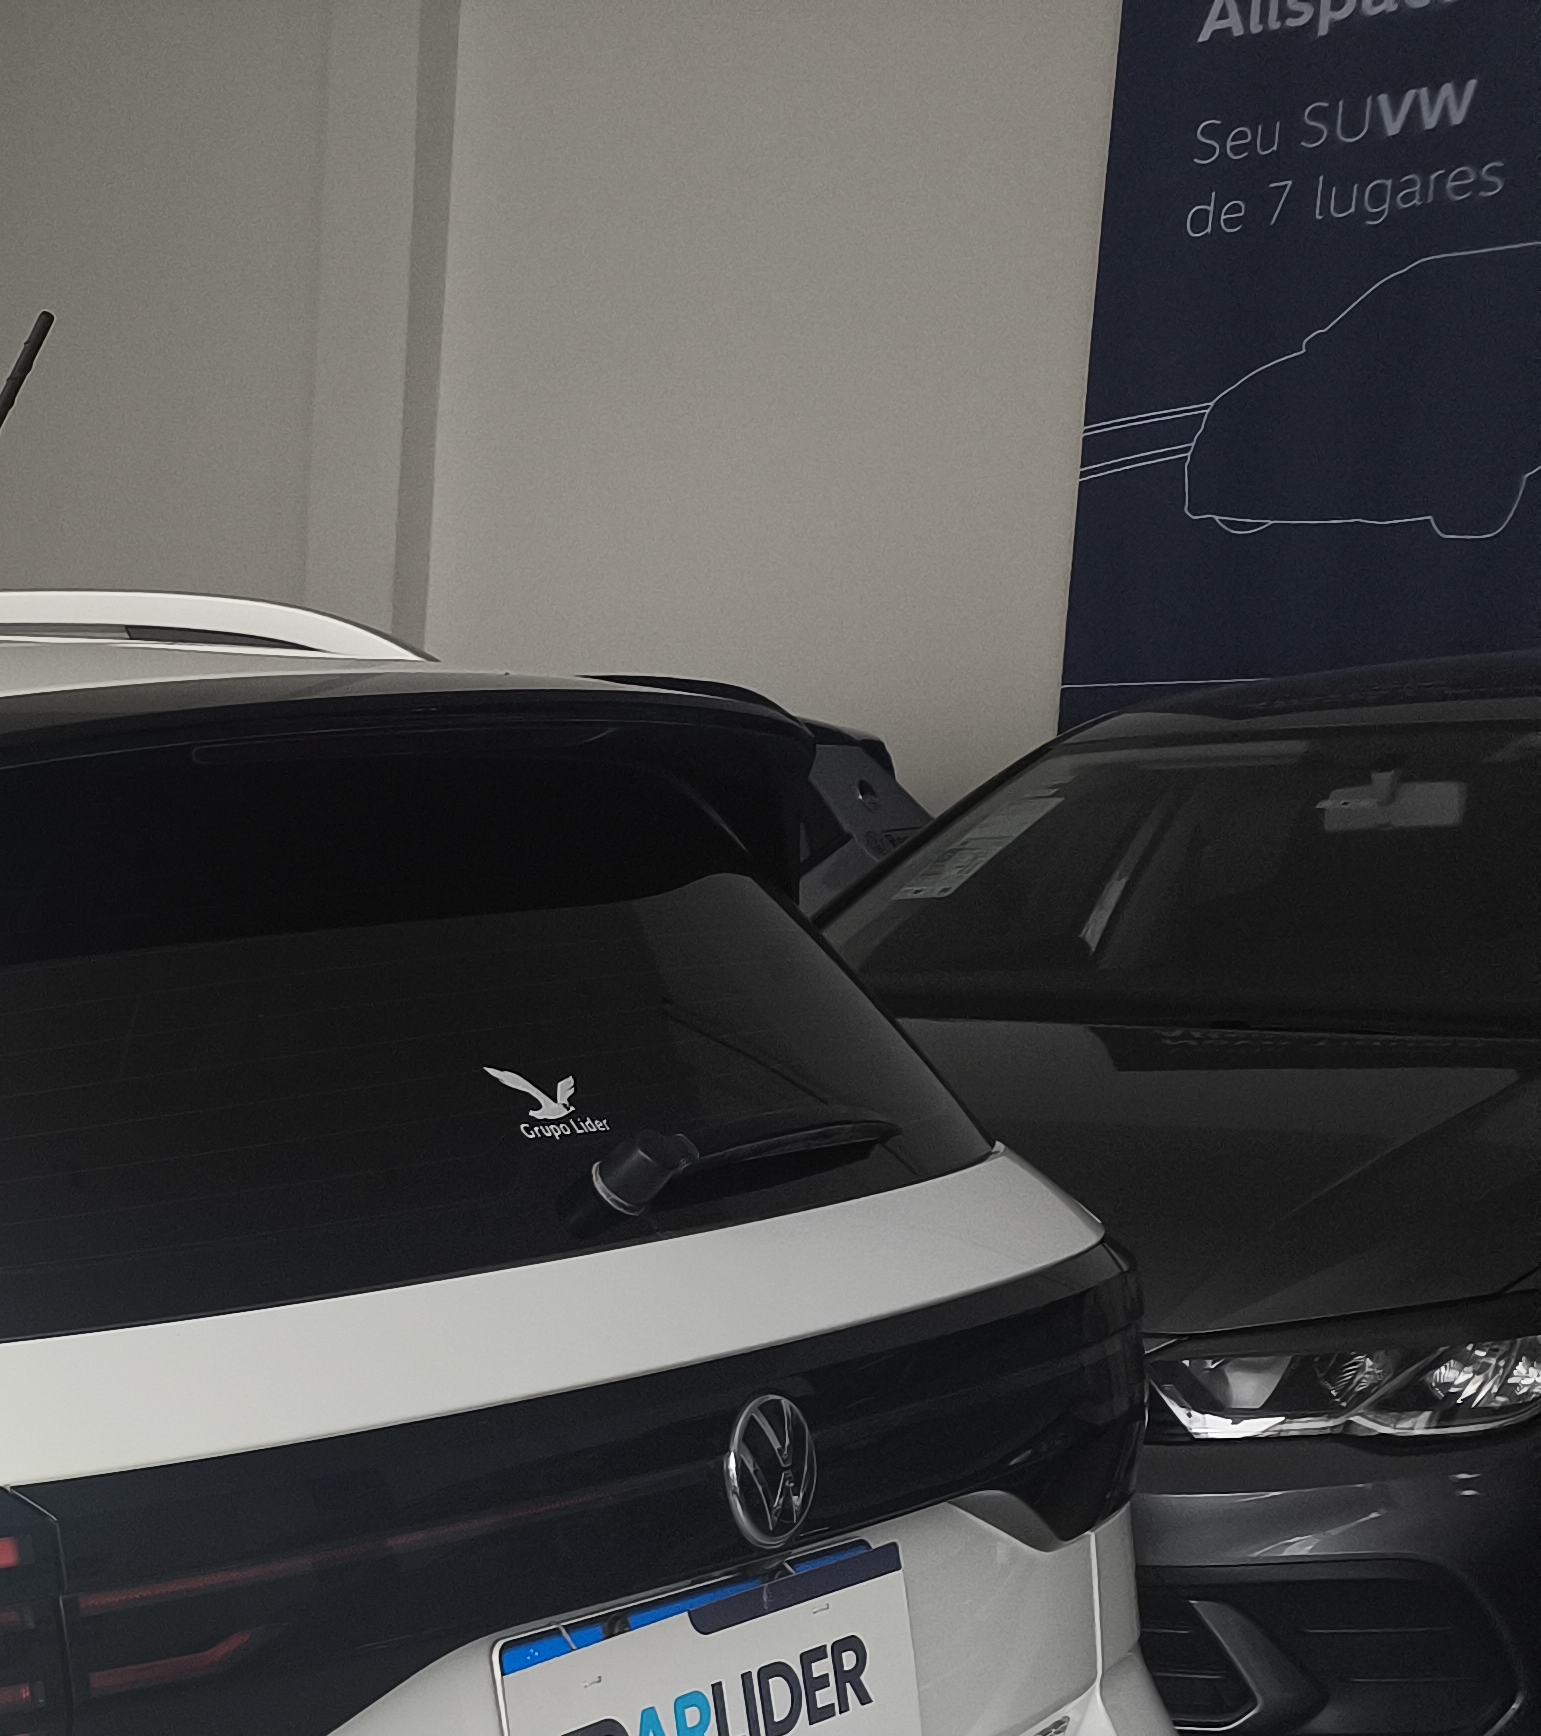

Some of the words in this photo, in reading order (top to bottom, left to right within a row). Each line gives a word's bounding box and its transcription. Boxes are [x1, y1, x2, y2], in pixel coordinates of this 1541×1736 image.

[1193, 119, 1280, 164] Seu
[1300, 78, 1477, 148] SUVW
[1186, 191, 1245, 237] de
[1269, 180, 1293, 225] 7
[1316, 161, 1505, 225] lugares
[520, 1123, 571, 1140] Grupo
[569, 1117, 610, 1134] Lider
